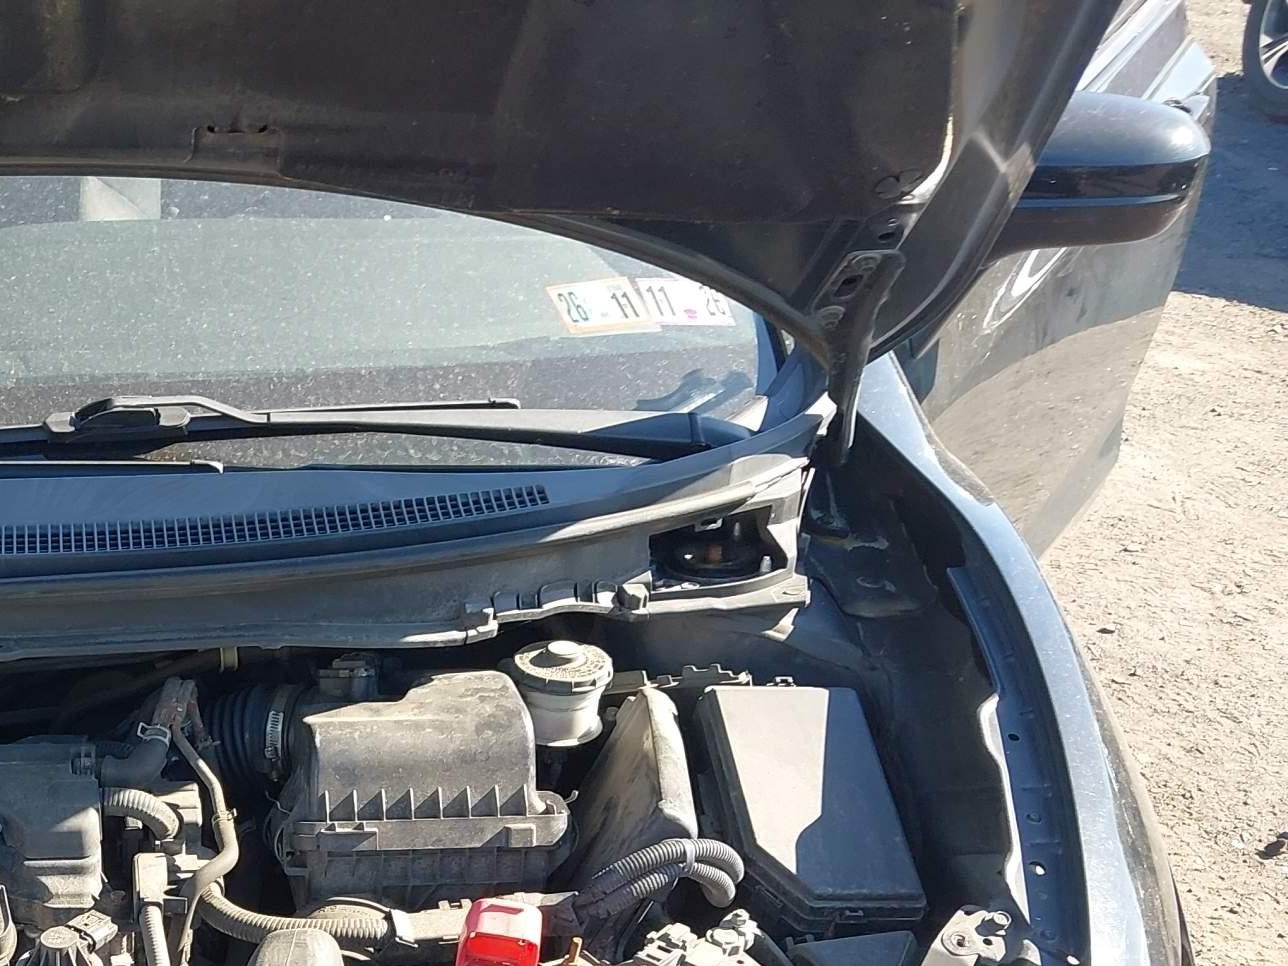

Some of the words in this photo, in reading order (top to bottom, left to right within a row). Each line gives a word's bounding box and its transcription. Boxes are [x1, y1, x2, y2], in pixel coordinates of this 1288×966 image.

[557, 291, 589, 323] 26
[610, 291, 640, 319] 11
[646, 285, 676, 316] 11
